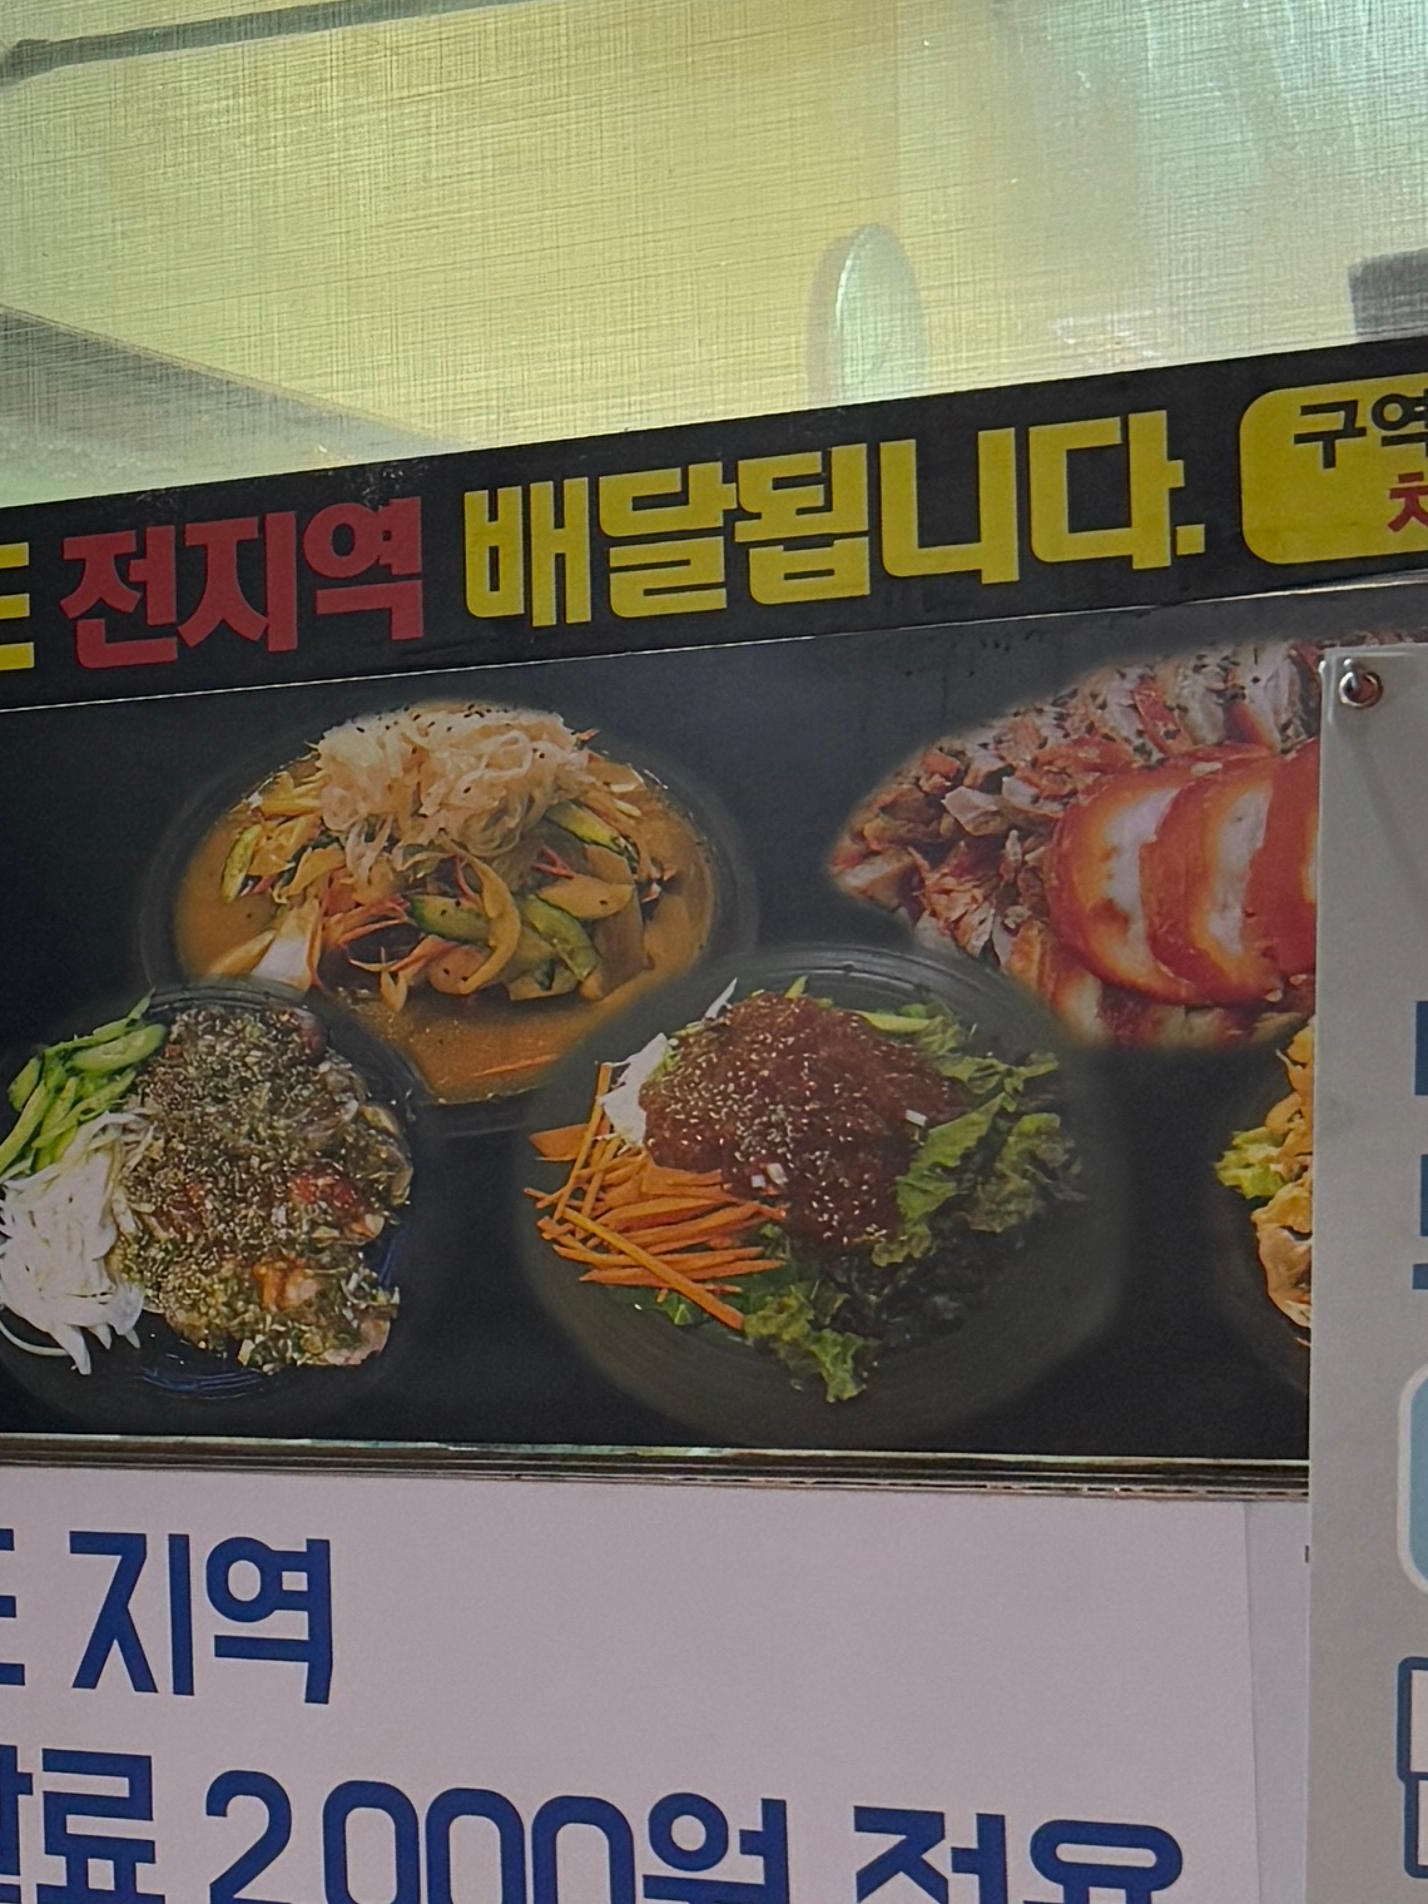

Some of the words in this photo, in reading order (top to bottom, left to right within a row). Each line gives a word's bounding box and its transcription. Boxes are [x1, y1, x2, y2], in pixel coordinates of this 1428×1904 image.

[59, 498, 425, 670] 전지역
[463, 408, 1207, 627] 배달됩니다.
[68, 1530, 333, 1705] 지역
